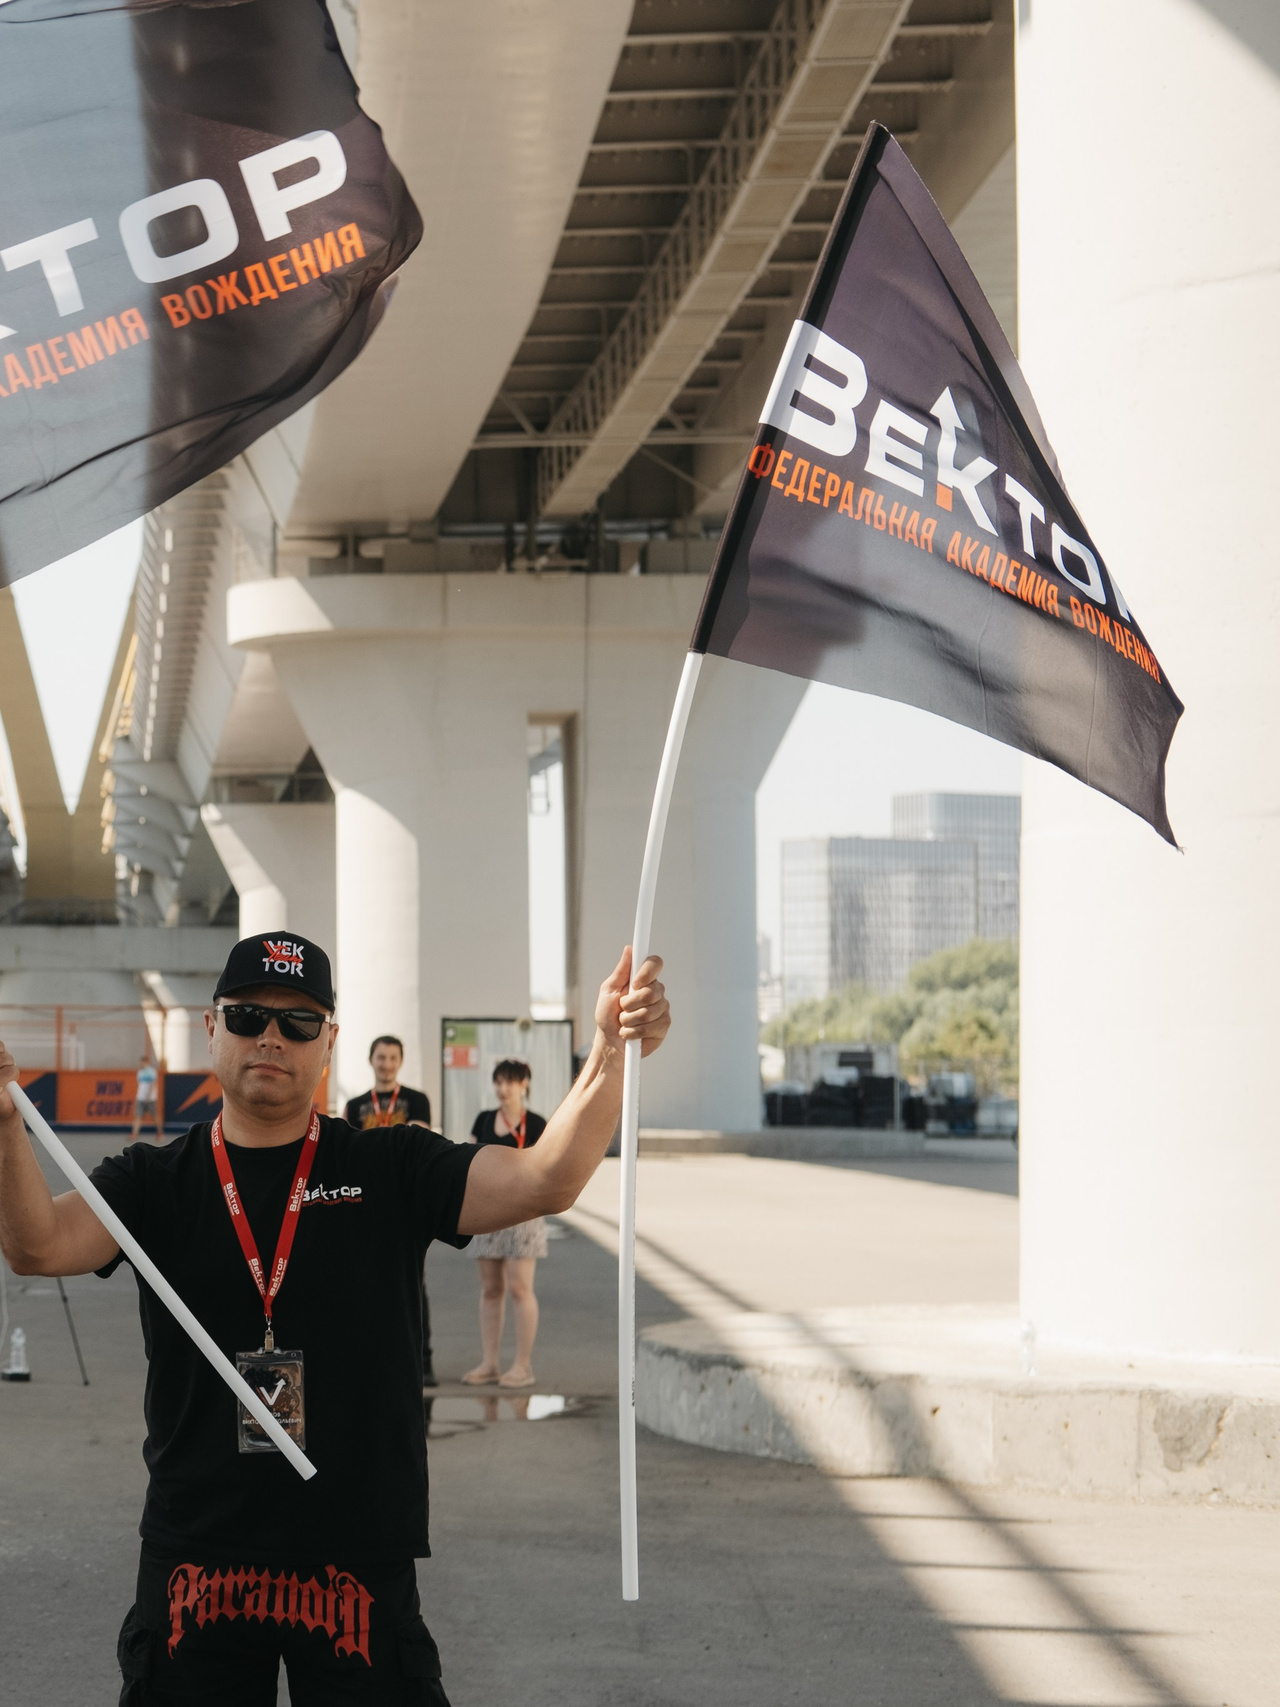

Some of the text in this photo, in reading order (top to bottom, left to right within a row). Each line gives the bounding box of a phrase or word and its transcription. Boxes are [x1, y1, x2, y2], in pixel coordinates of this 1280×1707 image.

[160, 221, 368, 330] ВОЖДЕНИЯ
[748, 442, 1162, 685] ФЕДЕРАЛЬНАЯ АКАДЕМИЯ ВОЖДЕНИЯ
[262, 957, 305, 978] TOR
[96, 1080, 125, 1096] WIN
[86, 1100, 134, 1117] COURT
